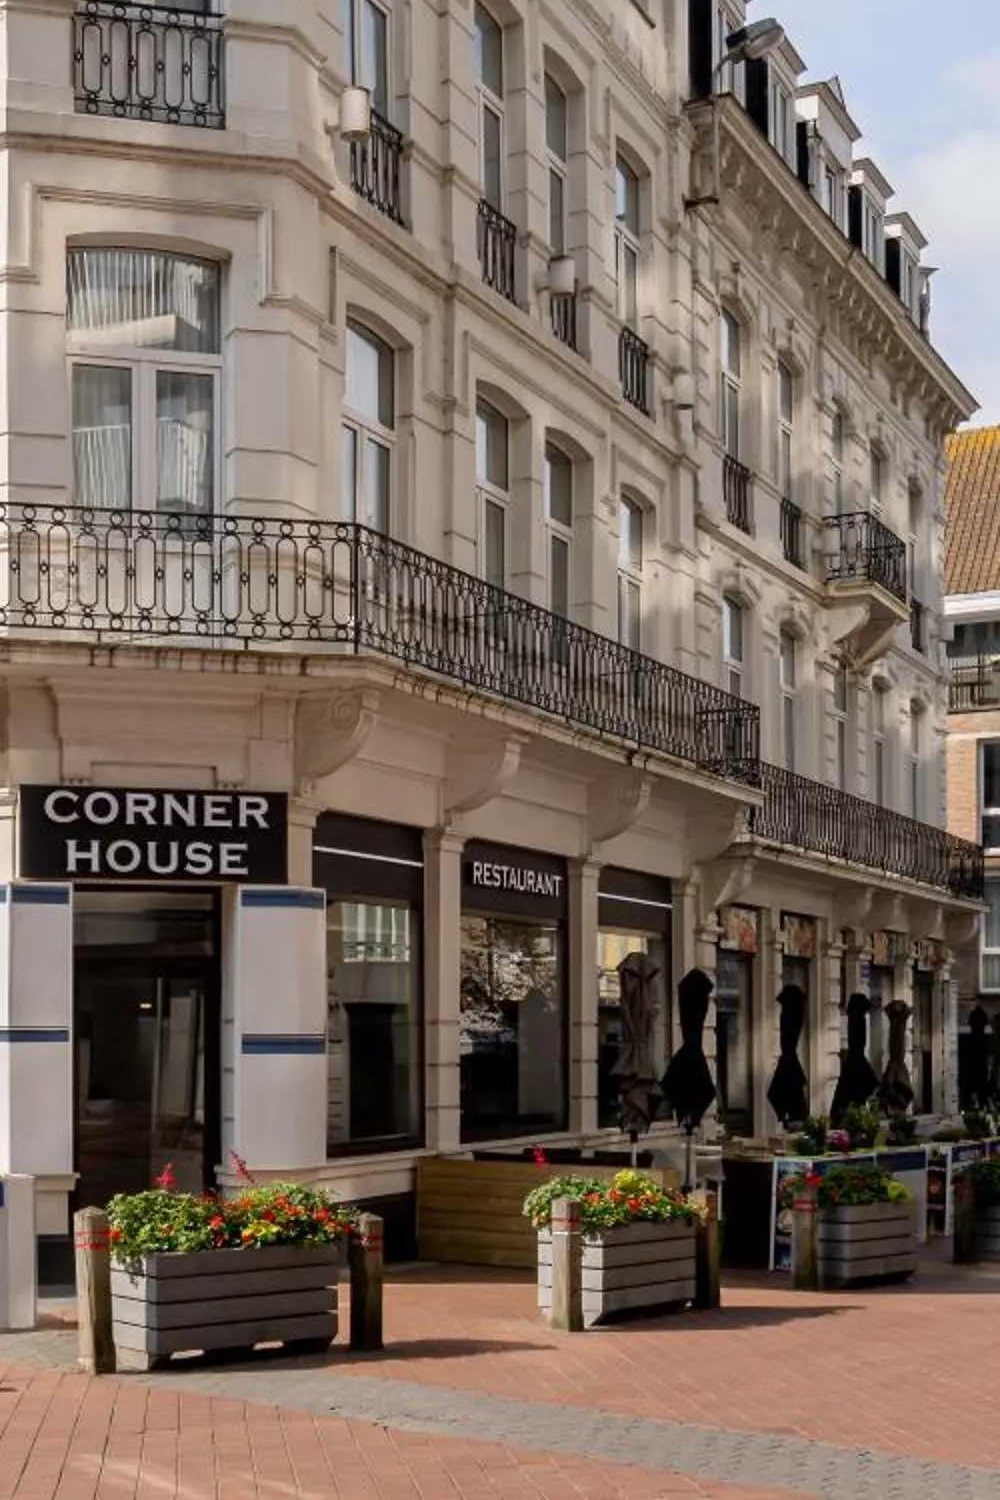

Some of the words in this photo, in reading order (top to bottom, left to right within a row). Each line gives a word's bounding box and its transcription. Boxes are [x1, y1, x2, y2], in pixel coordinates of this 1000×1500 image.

[43, 789, 270, 829] CORNER
[64, 839, 250, 876] HOUSE
[473, 860, 562, 897] RESTAURANT
